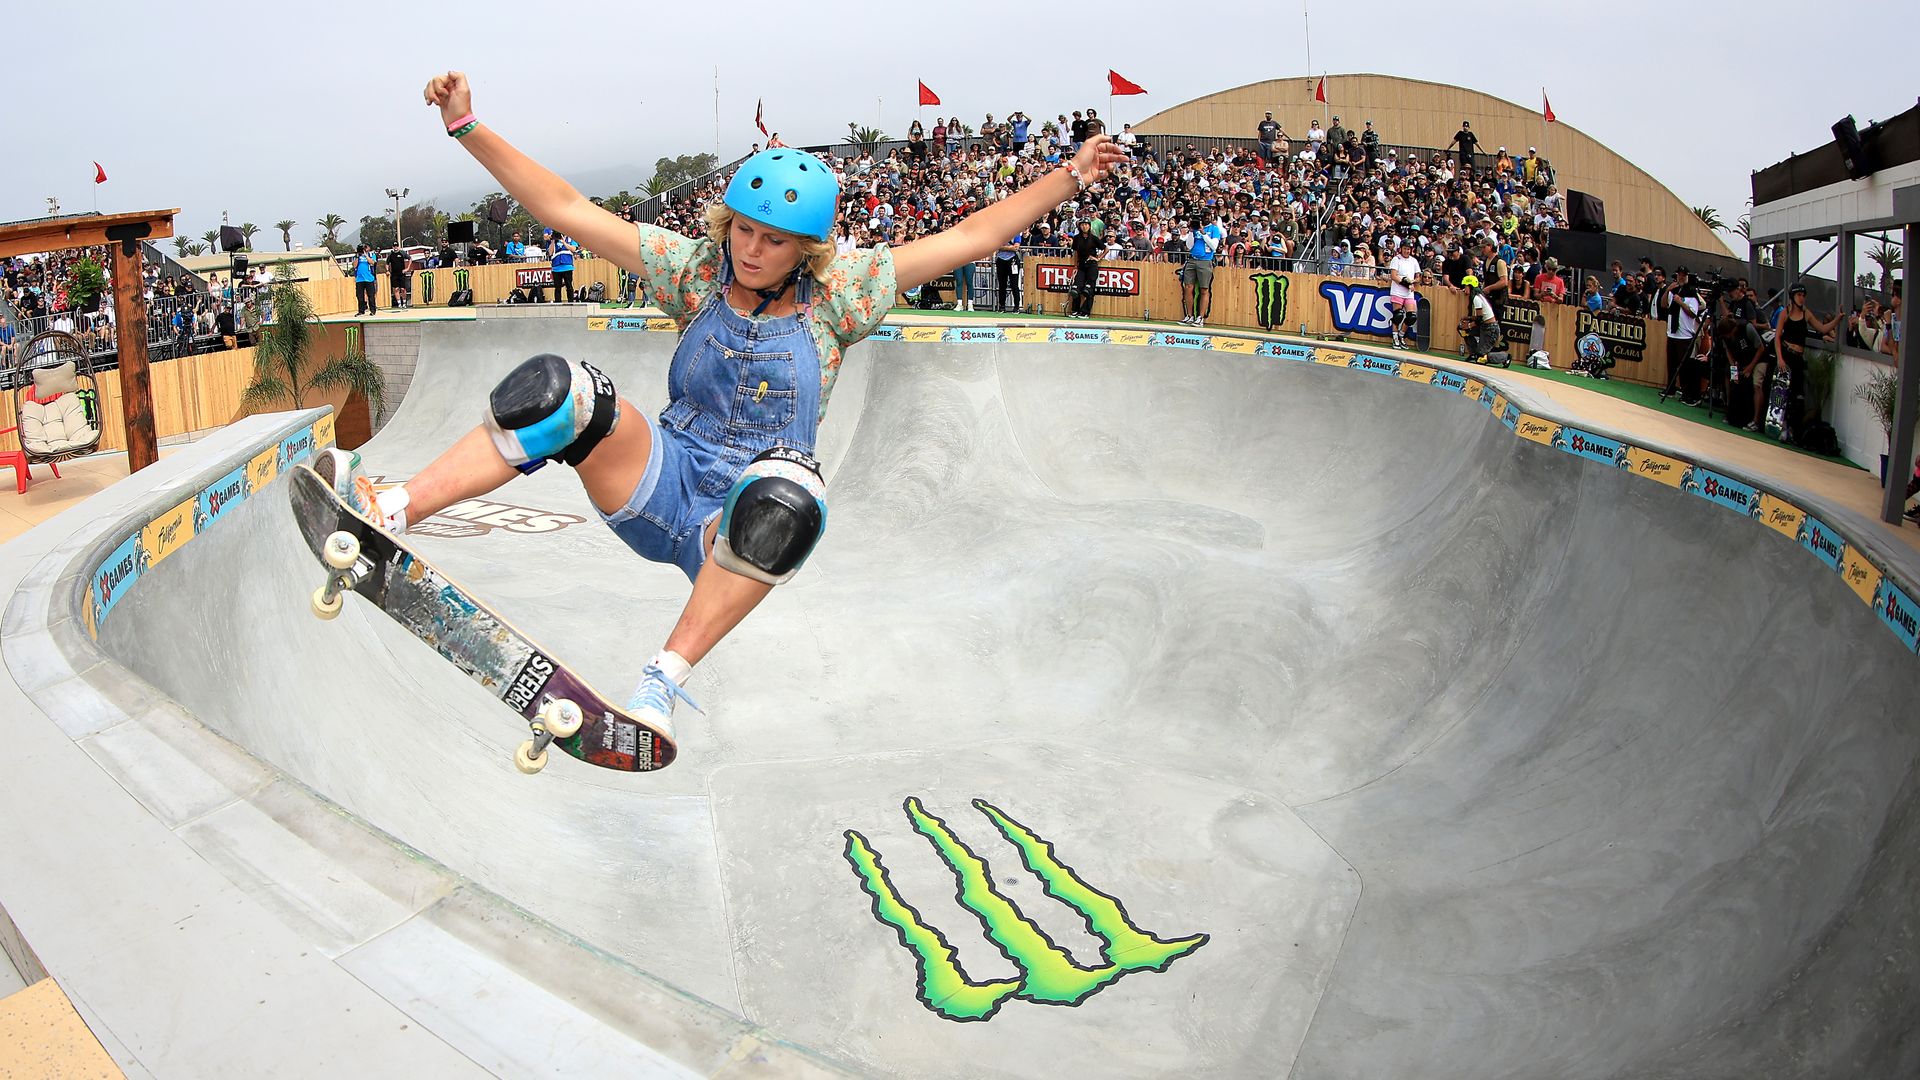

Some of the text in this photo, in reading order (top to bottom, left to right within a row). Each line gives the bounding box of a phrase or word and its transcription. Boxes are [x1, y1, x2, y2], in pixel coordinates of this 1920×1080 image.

[518, 269, 555, 285] THAYE
[1041, 267, 1134, 291] THERS
[1326, 288, 1417, 333] VIS
[1503, 305, 1537, 323] FICO
[1507, 328, 1530, 340] CLAR
[1579, 312, 1643, 340] PACIFICO
[1281, 348, 1305, 356] GAMES
[1613, 345, 1640, 358] CLARA
[1371, 361, 1392, 371] GAMES
[1520, 421, 1548, 434] California
[292, 436, 308, 455] GAMES
[1584, 441, 1614, 458] GAMES
[1640, 458, 1671, 472] California
[219, 480, 241, 506] GAMES
[1718, 485, 1748, 506] GAMES
[434, 499, 587, 533] MES
[1819, 536, 1838, 559] GAMES
[109, 553, 133, 590] GAMES
[1894, 604, 1917, 637] GAMES
[505, 655, 554, 713] STEREO
[639, 730, 652, 770] CONVERSE
